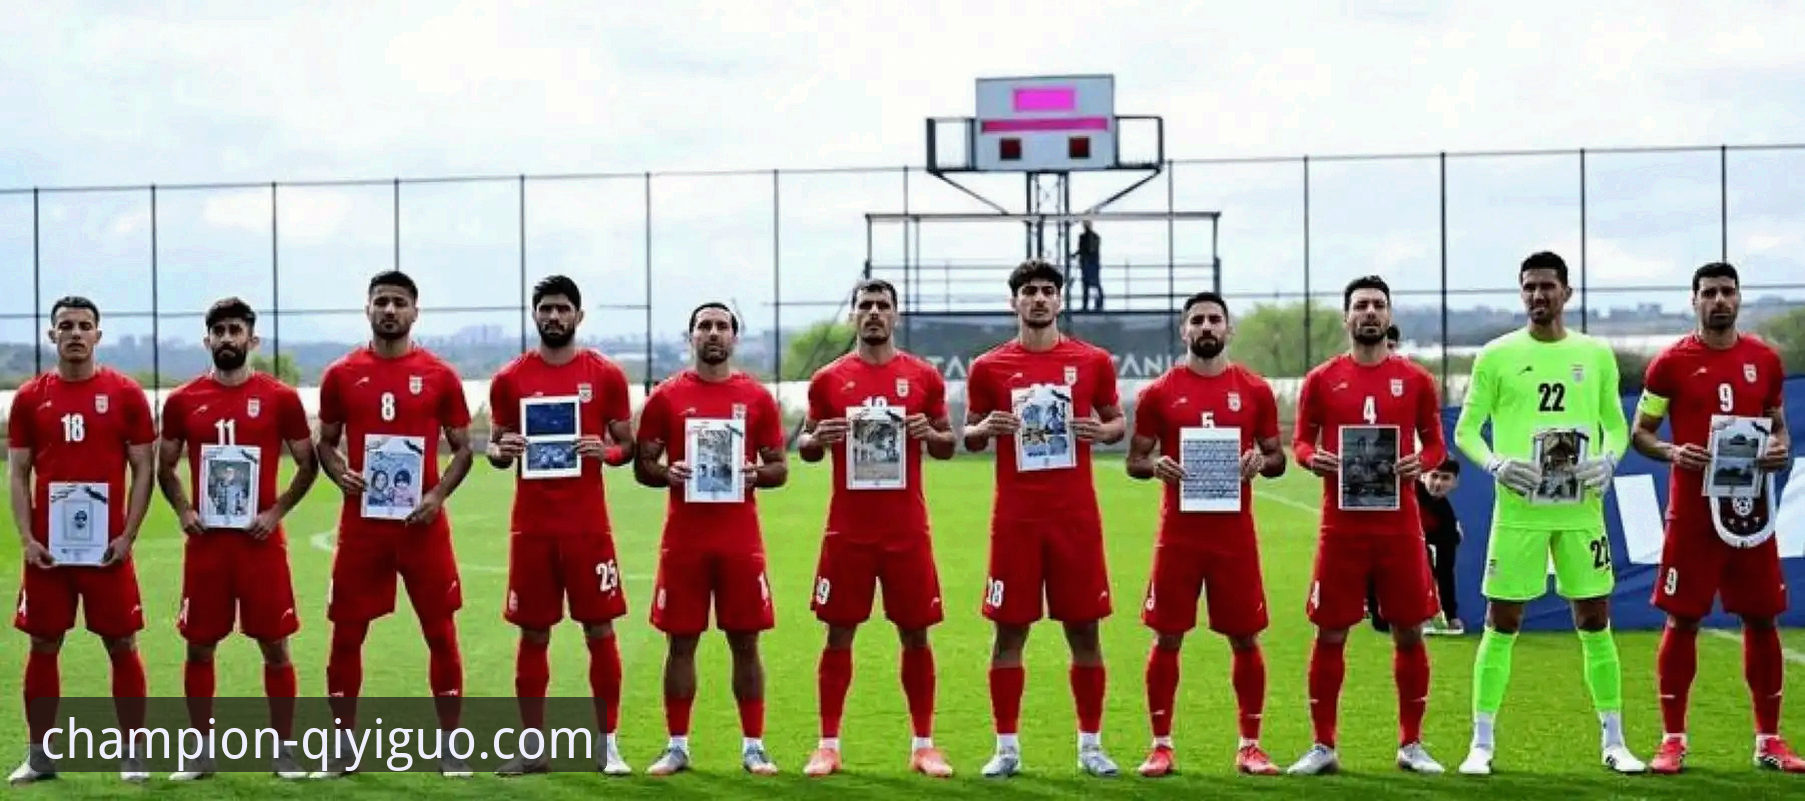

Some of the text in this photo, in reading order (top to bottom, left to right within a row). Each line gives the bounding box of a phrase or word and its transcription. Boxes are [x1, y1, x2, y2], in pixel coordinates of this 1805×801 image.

[381, 391, 395, 420] 8
[1363, 395, 1377, 425] 4
[1538, 383, 1565, 412] 22
[1718, 383, 1733, 412] 9
[60, 413, 85, 441] 18
[214, 419, 235, 445] 11
[1665, 567, 1678, 595] 9
